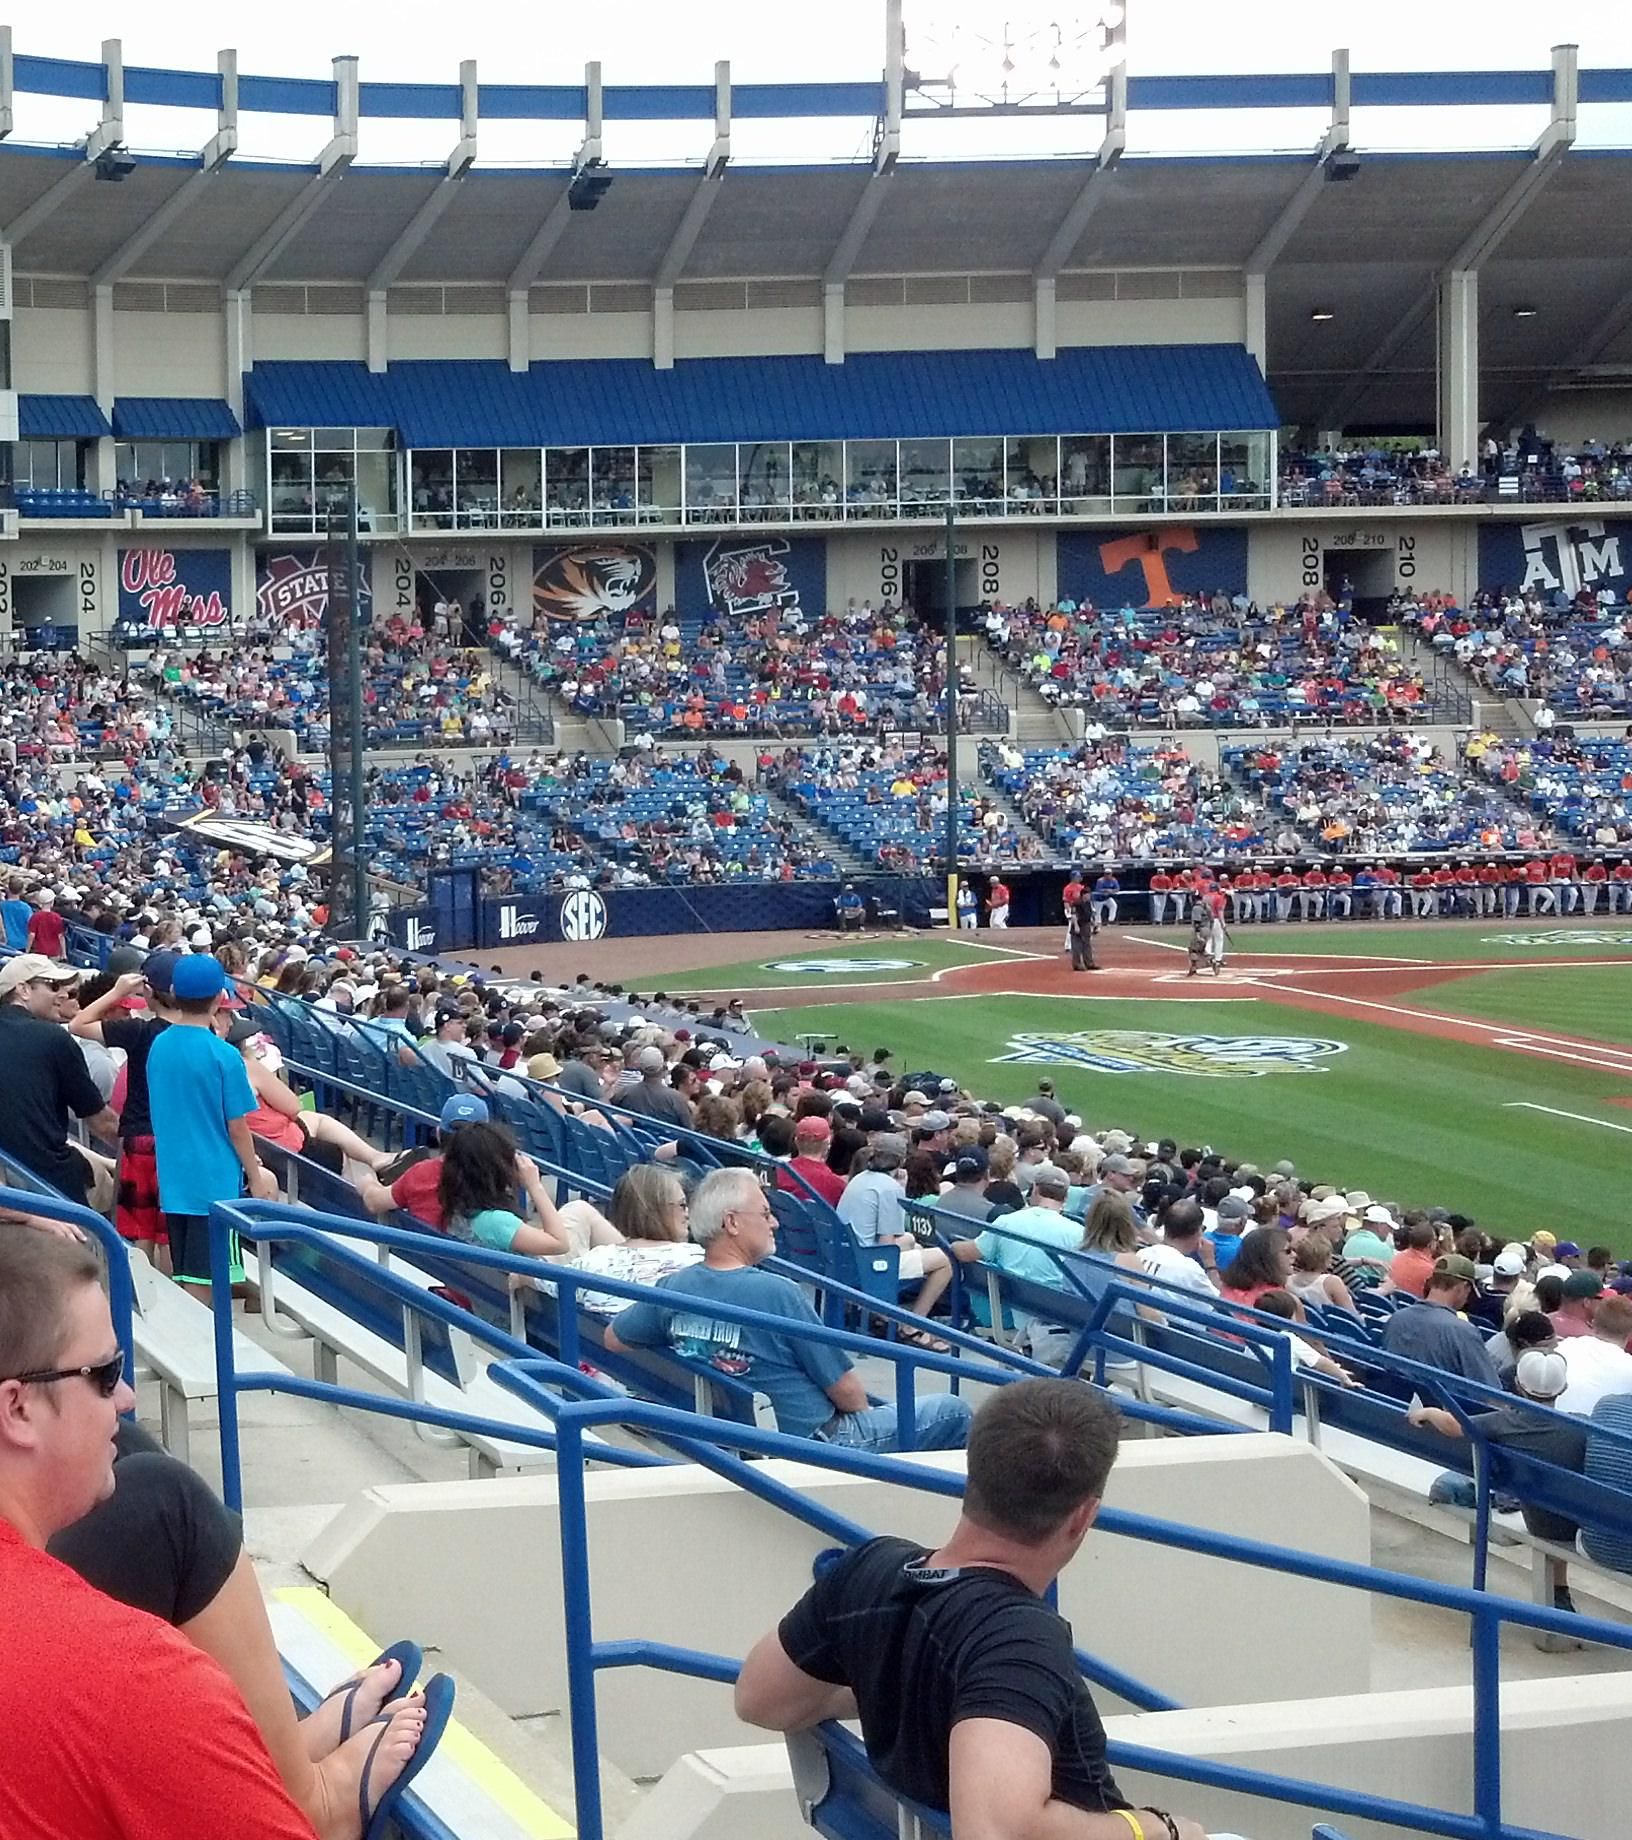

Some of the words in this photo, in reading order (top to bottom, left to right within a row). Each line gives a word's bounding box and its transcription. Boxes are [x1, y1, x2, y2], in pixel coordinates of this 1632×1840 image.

[952, 544, 968, 555] 08
[1302, 537, 1319, 586] 208
[1362, 534, 1385, 546] 210
[1399, 536, 1416, 578] 210
[20, 561, 39, 572] 202
[48, 560, 67, 572] 204
[80, 562, 96, 614] 204
[122, 549, 176, 594] Ole
[395, 558, 411, 609] 204
[490, 556, 506, 606] 206
[881, 547, 898, 596] 206
[982, 545, 999, 594] 208
[1099, 527, 1199, 609] T
[499, 905, 540, 939] Hoover
[565, 891, 603, 941] SEC
